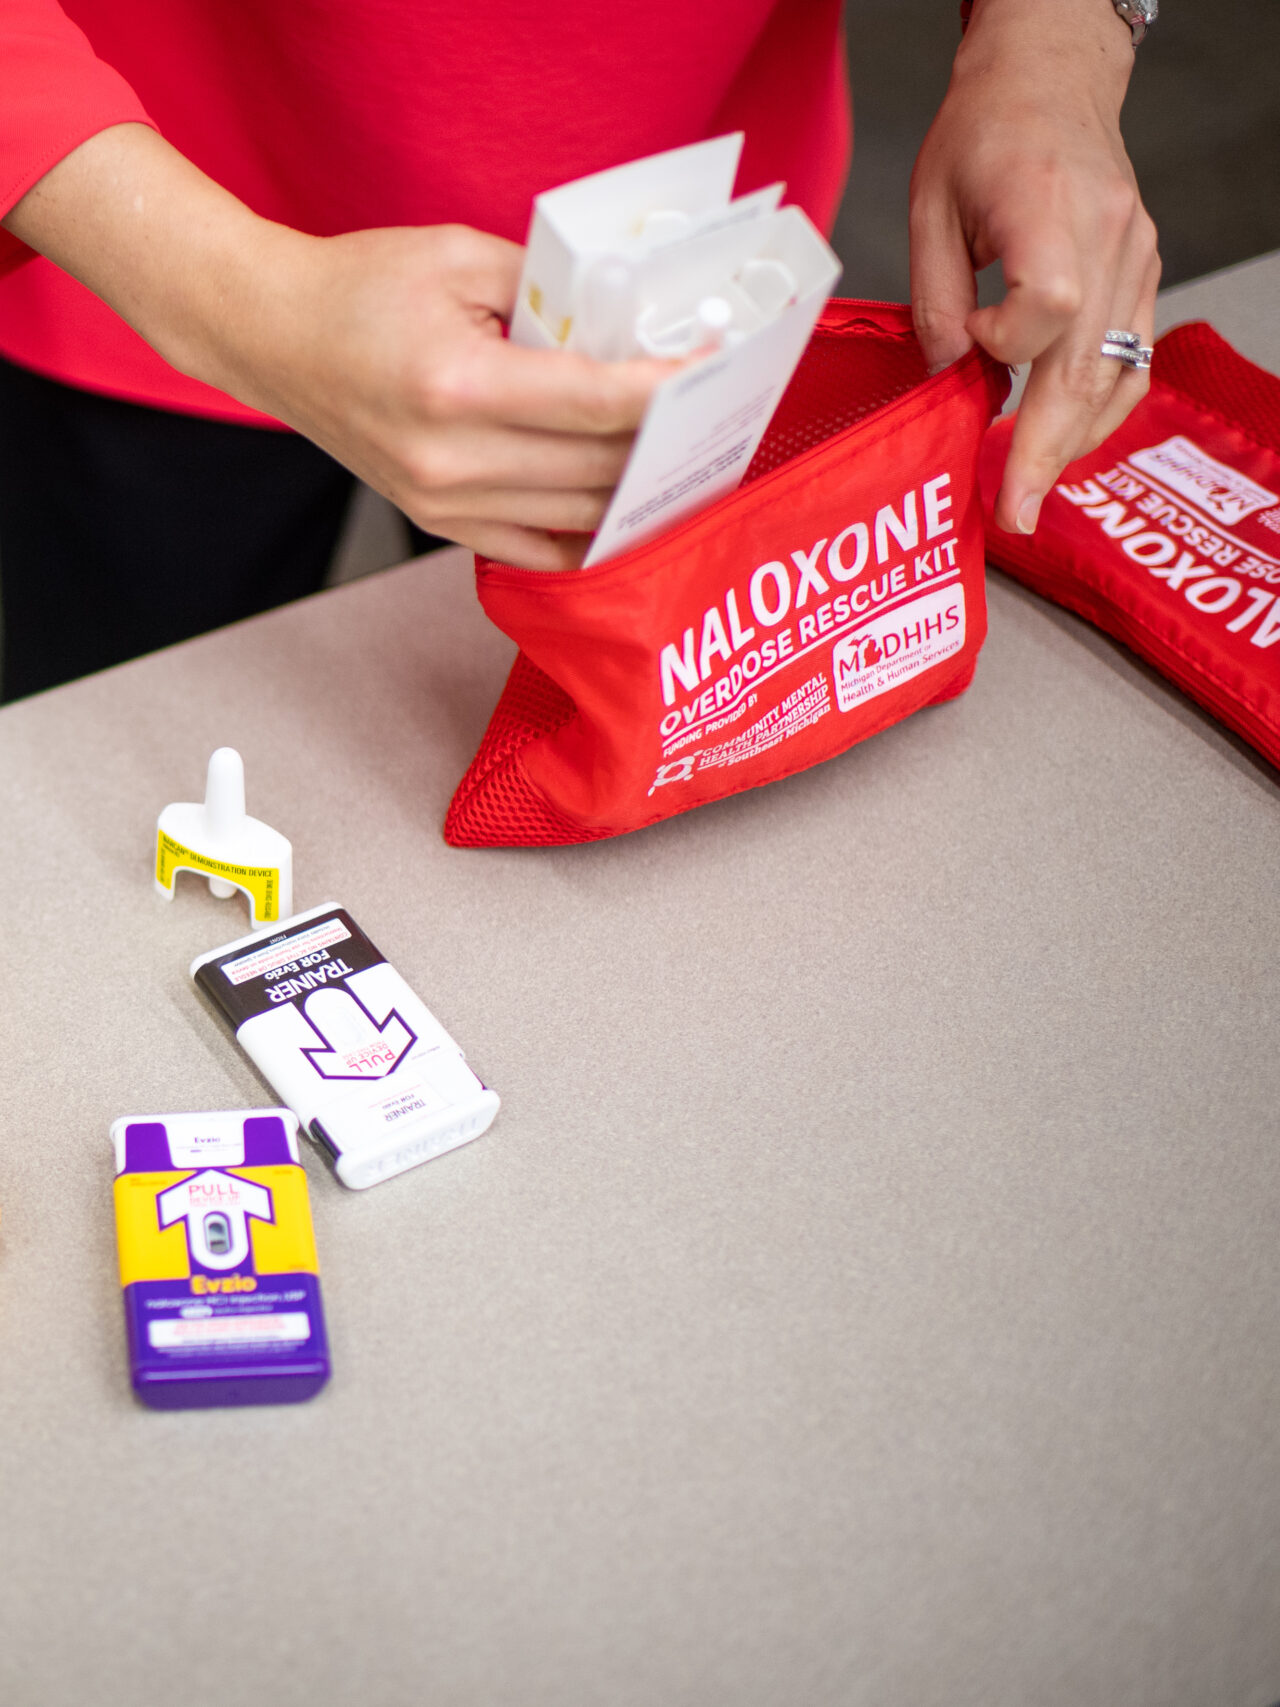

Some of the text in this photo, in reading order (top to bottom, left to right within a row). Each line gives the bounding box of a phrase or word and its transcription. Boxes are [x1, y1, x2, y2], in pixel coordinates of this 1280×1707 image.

[1094, 466, 1146, 501] KIT
[1135, 493, 1242, 568] RESCUE
[1057, 478, 1280, 648] ALOXONE
[1232, 555, 1280, 584] OSE
[660, 472, 955, 707] NALOXONE
[660, 538, 959, 737] OVERDOSE RESCUE KIT
[840, 668, 875, 692] Michigan
[876, 646, 923, 674] Department
[843, 640, 960, 704] Health & Human Services
[663, 693, 758, 758] FUNDING PROVIDED BY
[700, 684, 830, 766] HEALTH PARTNERSHIP
[702, 672, 827, 757] COMMUNITY MENTAL
[727, 737, 784, 766] Southeast
[784, 702, 832, 740] Michigan
[189, 852, 247, 876] DEMONSTRATION
[248, 869, 273, 878] DEVICE
[269, 934, 287, 945] FRONT
[264, 948, 331, 981] FOR Evzio
[264, 958, 355, 1003] TRAINER
[348, 1048, 396, 1073] PULL
[384, 1098, 427, 1122] TRAINER
[188, 1183, 240, 1196] PULL
[191, 1273, 257, 1295] Evzio
